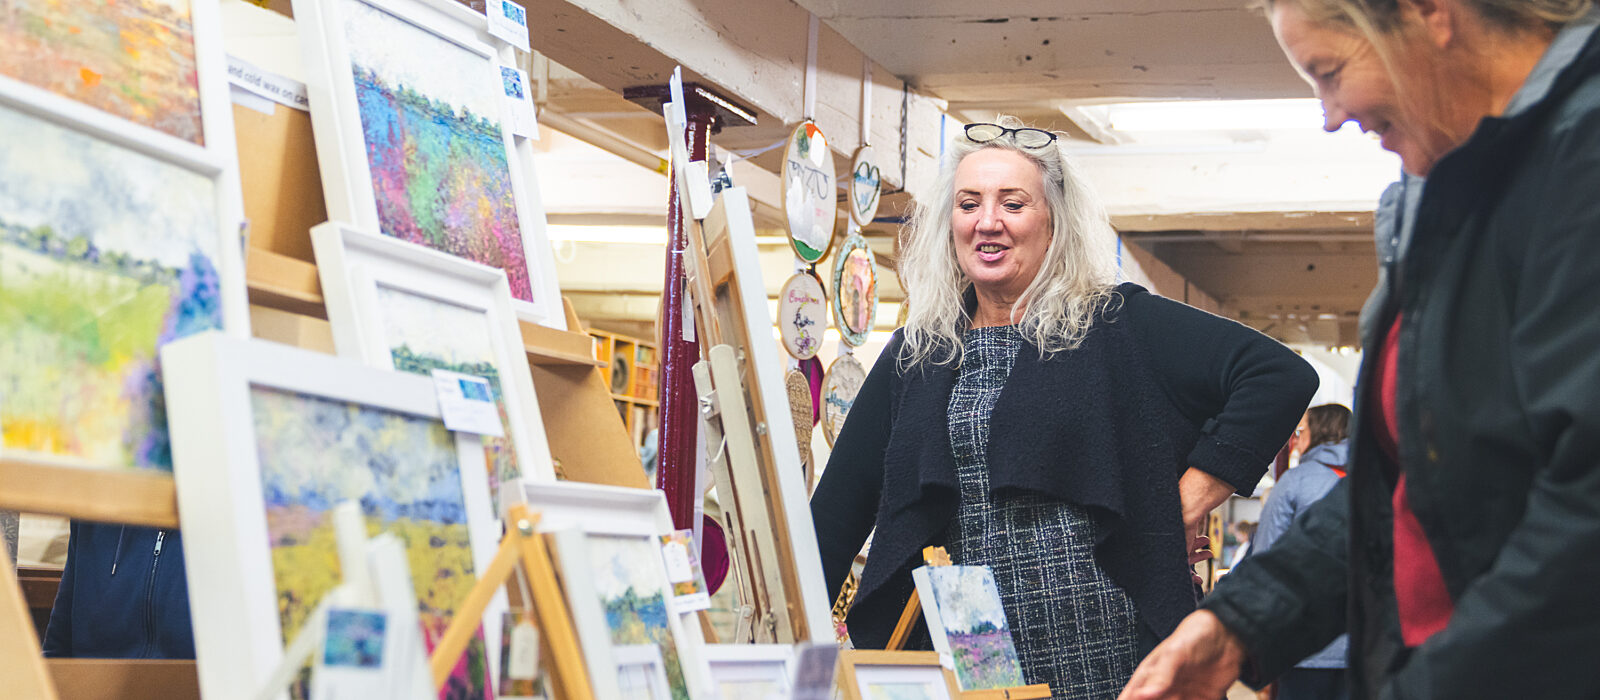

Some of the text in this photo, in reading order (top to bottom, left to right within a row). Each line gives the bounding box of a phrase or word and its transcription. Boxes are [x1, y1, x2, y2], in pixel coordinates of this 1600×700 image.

[228, 64, 243, 78] and
[244, 73, 261, 87] cold
[263, 82, 280, 94] wax
[282, 89, 293, 100] on
